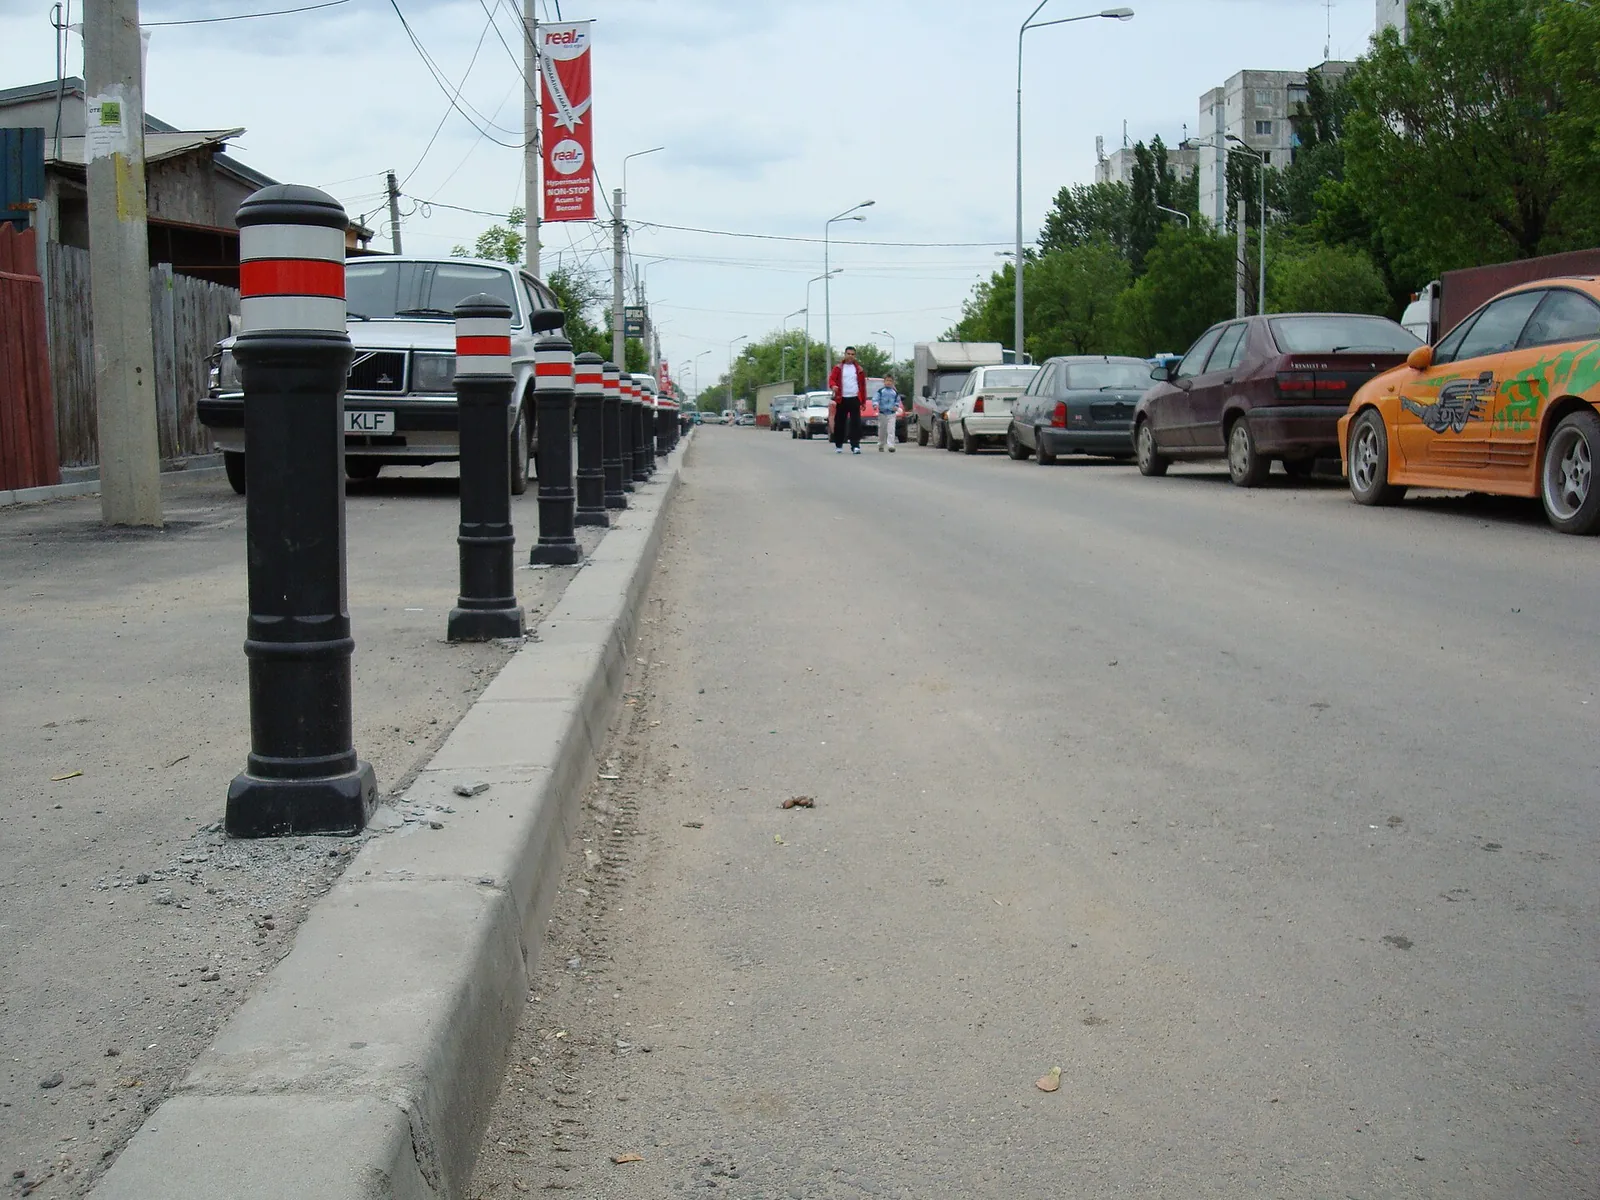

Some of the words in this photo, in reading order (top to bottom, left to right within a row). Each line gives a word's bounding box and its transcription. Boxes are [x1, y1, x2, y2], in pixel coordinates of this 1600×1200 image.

[546, 178, 590, 187] Hypermarket
[547, 187, 590, 196] NON-STOP
[556, 204, 582, 212] Berceni
[351, 413, 386, 430] KLF
